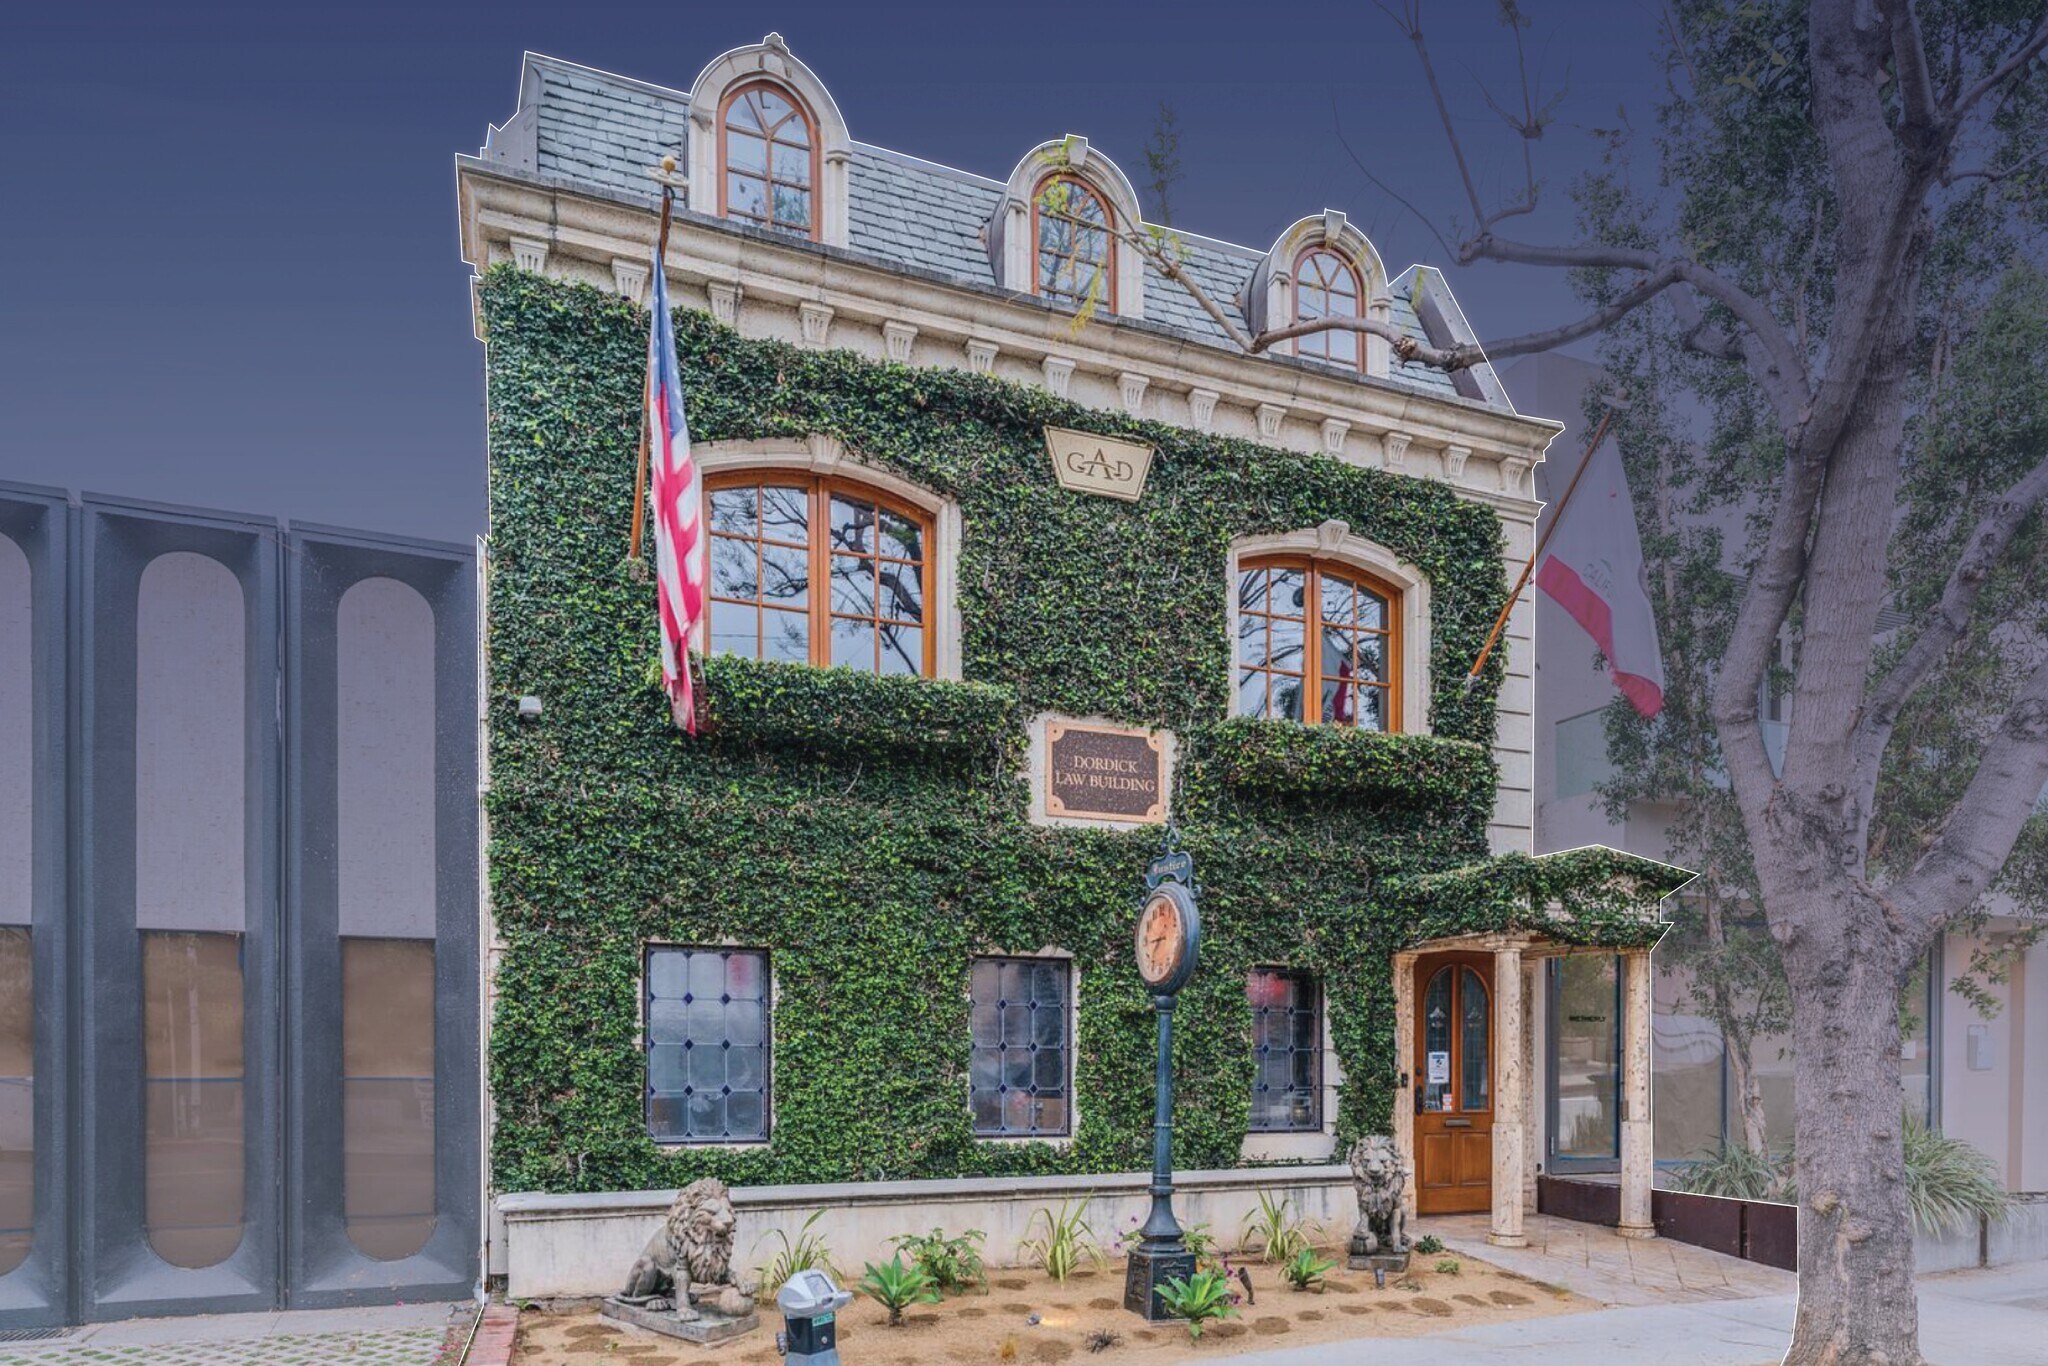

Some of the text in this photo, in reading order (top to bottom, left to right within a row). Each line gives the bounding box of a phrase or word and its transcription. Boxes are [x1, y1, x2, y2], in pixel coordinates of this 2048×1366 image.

[1067, 448, 1133, 482] GAD
[1074, 756, 1138, 773] DORDICK
[1055, 771, 1155, 792] LAW BUILDING
